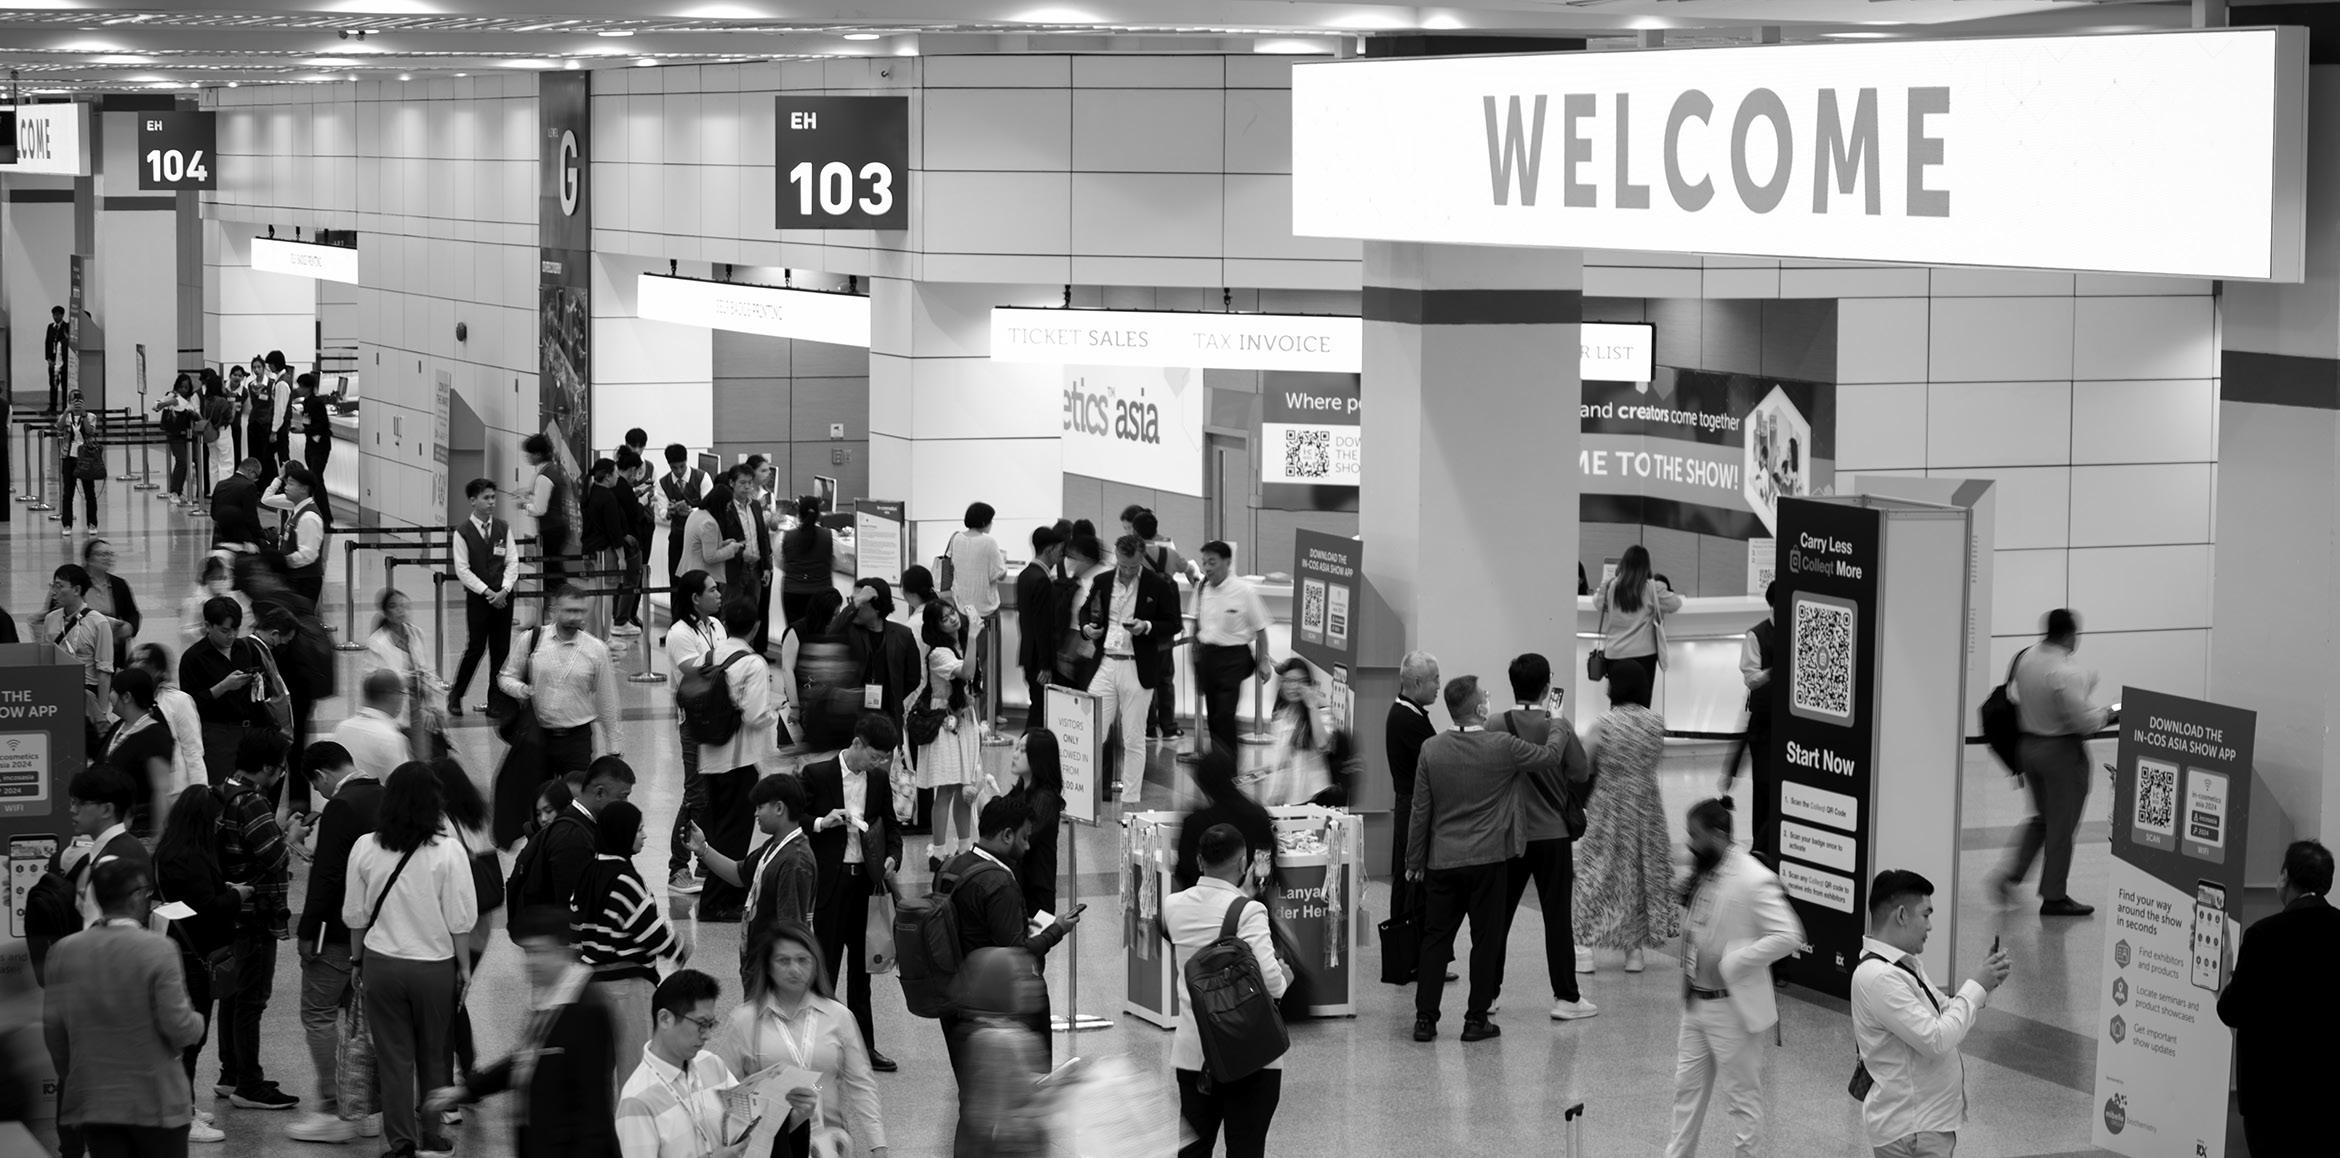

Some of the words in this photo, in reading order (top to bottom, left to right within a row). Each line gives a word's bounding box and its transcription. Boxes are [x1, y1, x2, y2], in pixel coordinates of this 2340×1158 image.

[146, 120, 163, 131] EH
[790, 112, 817, 129] EH
[17, 118, 51, 159] COME
[1484, 86, 1950, 217] WELCOME
[146, 150, 208, 182] 104
[560, 129, 578, 216] G
[790, 161, 893, 215] 103
[1008, 327, 1082, 345] TICKET
[1089, 329, 1149, 348] SALES
[1193, 332, 1231, 349] TAX
[1240, 334, 1330, 353] INVOICE
[1596, 345, 1634, 360] LIST
[1285, 392, 1342, 410] Where
[1115, 387, 1161, 445] asia
[1580, 402, 1613, 419] and
[1617, 403, 1669, 423] creators
[1671, 410, 1698, 427] come
[1700, 412, 1740, 433] together
[1336, 450, 1358, 461] THE
[1615, 450, 1651, 477] TO
[1653, 452, 1683, 483] THE
[1686, 458, 1739, 490] SHOW!
[1800, 531, 1827, 554] Carry
[1829, 536, 1853, 555] Less
[1309, 548, 1338, 563] DOWNLOAD
[1338, 553, 1348, 566] THE
[1302, 558, 1319, 571] IN-COS
[1319, 562, 1330, 573] ASIA
[1330, 564, 1344, 576] SHOW
[1344, 567, 1354, 577] APP
[1802, 555, 1834, 577] Colleqt
[1836, 560, 1863, 580] More
[1, 690, 32, 703] THE
[28, 705, 58, 718] APP
[1058, 717, 1084, 731] VISITORS
[2149, 715, 2204, 738] DOWNLOAD
[2205, 727, 2224, 743] THE
[1063, 734, 1079, 745] ONLY
[2134, 729, 2167, 747] IN-COS
[2167, 736, 2188, 752] ASIA
[2189, 740, 2218, 758] SHOW
[2218, 747, 2236, 762] APP
[12, 761, 32, 769] 2024
[1082, 754, 1089, 763] IN
[1786, 740, 1820, 769] Start
[1823, 748, 1855, 777] Now
[1063, 764, 1079, 776] FROM
[4, 787, 22, 795] 2024
[1075, 783, 1085, 793] AM
[1790, 797, 1802, 806] Scan
[1827, 806, 1834, 814] QR
[1835, 808, 1847, 817] Code
[1790, 832, 1801, 841] Scan
[1812, 837, 1826, 848] badge
[1788, 870, 1800, 880] Scan
[1825, 880, 1832, 889] QR
[1278, 886, 1323, 902] Lanya
[2118, 888, 2136, 902] Find
[2136, 895, 2154, 907] your
[2156, 900, 2172, 914] way
[2116, 915, 2124, 926] in
[2125, 918, 2157, 935] seconds
[2117, 904, 2145, 918] around
[2147, 909, 2160, 922] the
[2161, 914, 2183, 928] show
[2138, 946, 2152, 959] Find
[2153, 951, 2184, 968] exhibitors
[2137, 960, 2150, 971] and
[2151, 964, 2179, 980] products
[2136, 985, 2158, 1000] Locate
[2159, 992, 2186, 1007] seminars
[2187, 1001, 2200, 1012] and
[2135, 999, 2160, 1014] product
[2161, 1006, 2195, 1024] showcases
[2133, 1023, 2146, 1035] Get
[2146, 1028, 2177, 1044] important
[2132, 1036, 2150, 1049] show
[2150, 1042, 2176, 1058] updates
